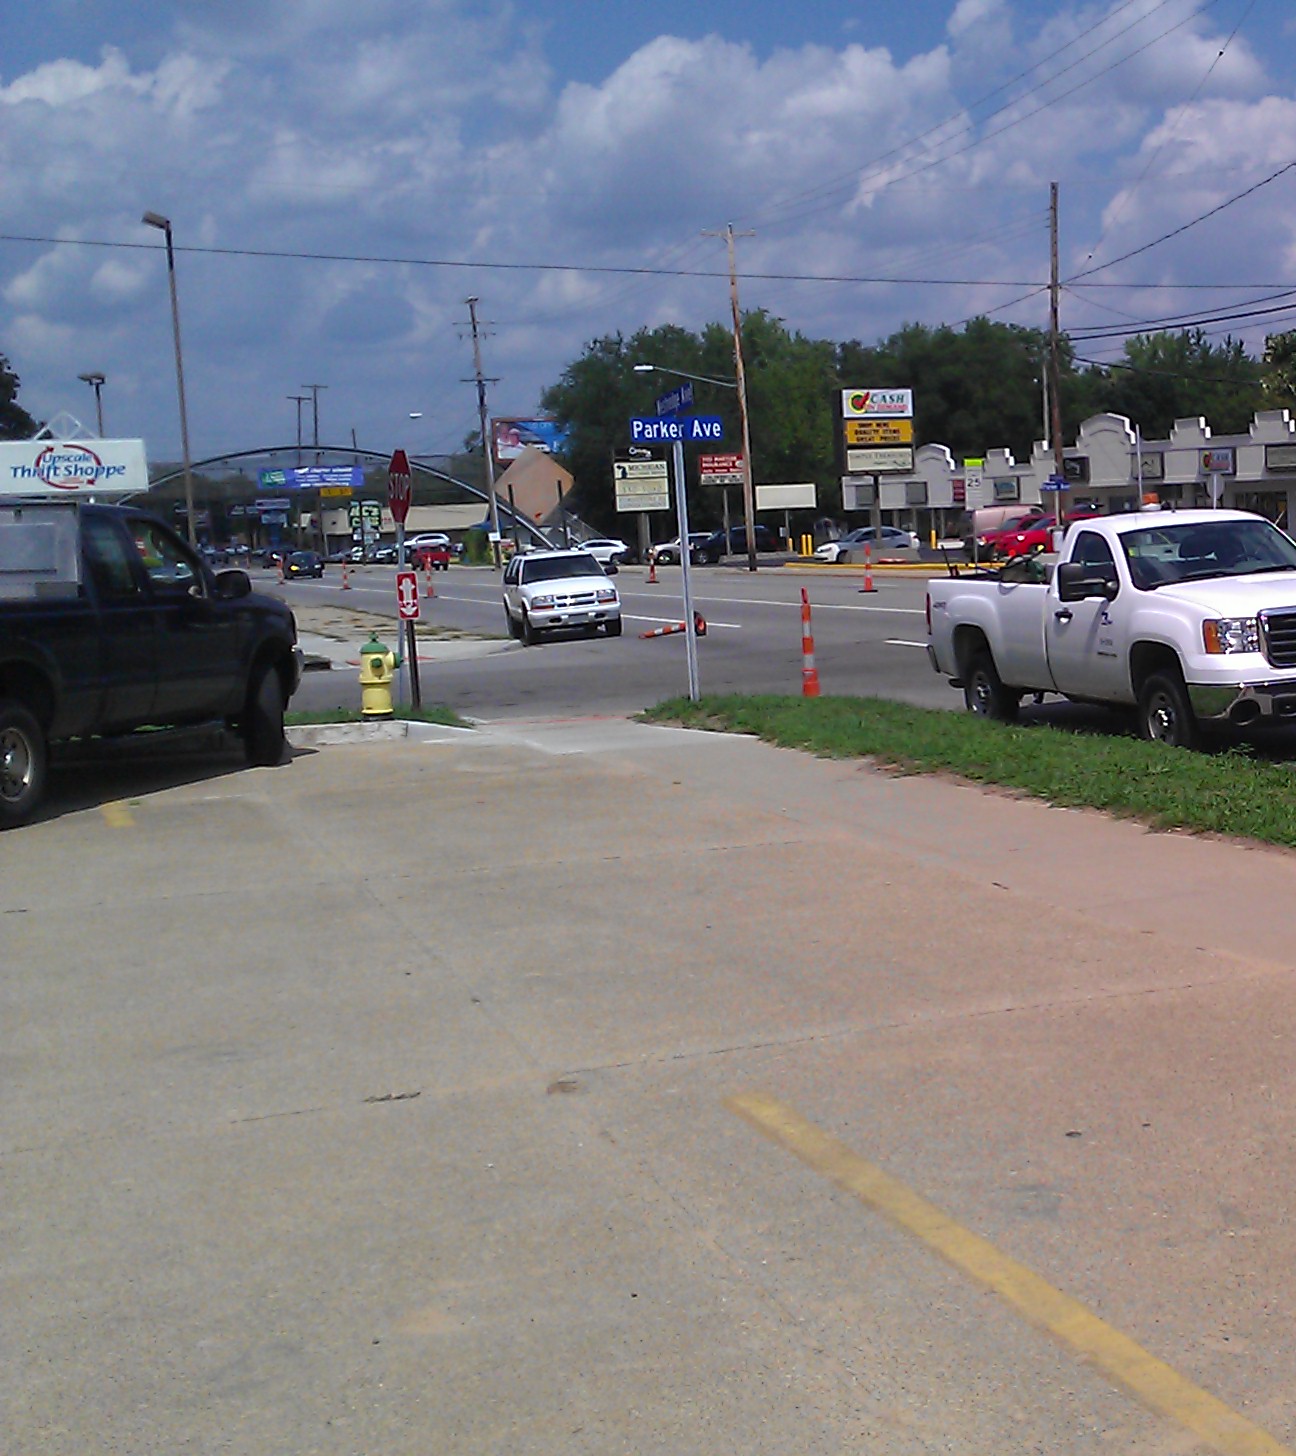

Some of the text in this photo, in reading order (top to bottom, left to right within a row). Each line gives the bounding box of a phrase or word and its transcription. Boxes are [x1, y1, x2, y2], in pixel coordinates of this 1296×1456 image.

[871, 394, 905, 403] CASH
[632, 419, 721, 438] Parker Ave
[42, 454, 92, 466] Upscale
[10, 464, 126, 479] Thrift Shoppe
[388, 473, 409, 500] STOP
[967, 478, 981, 488] 25
